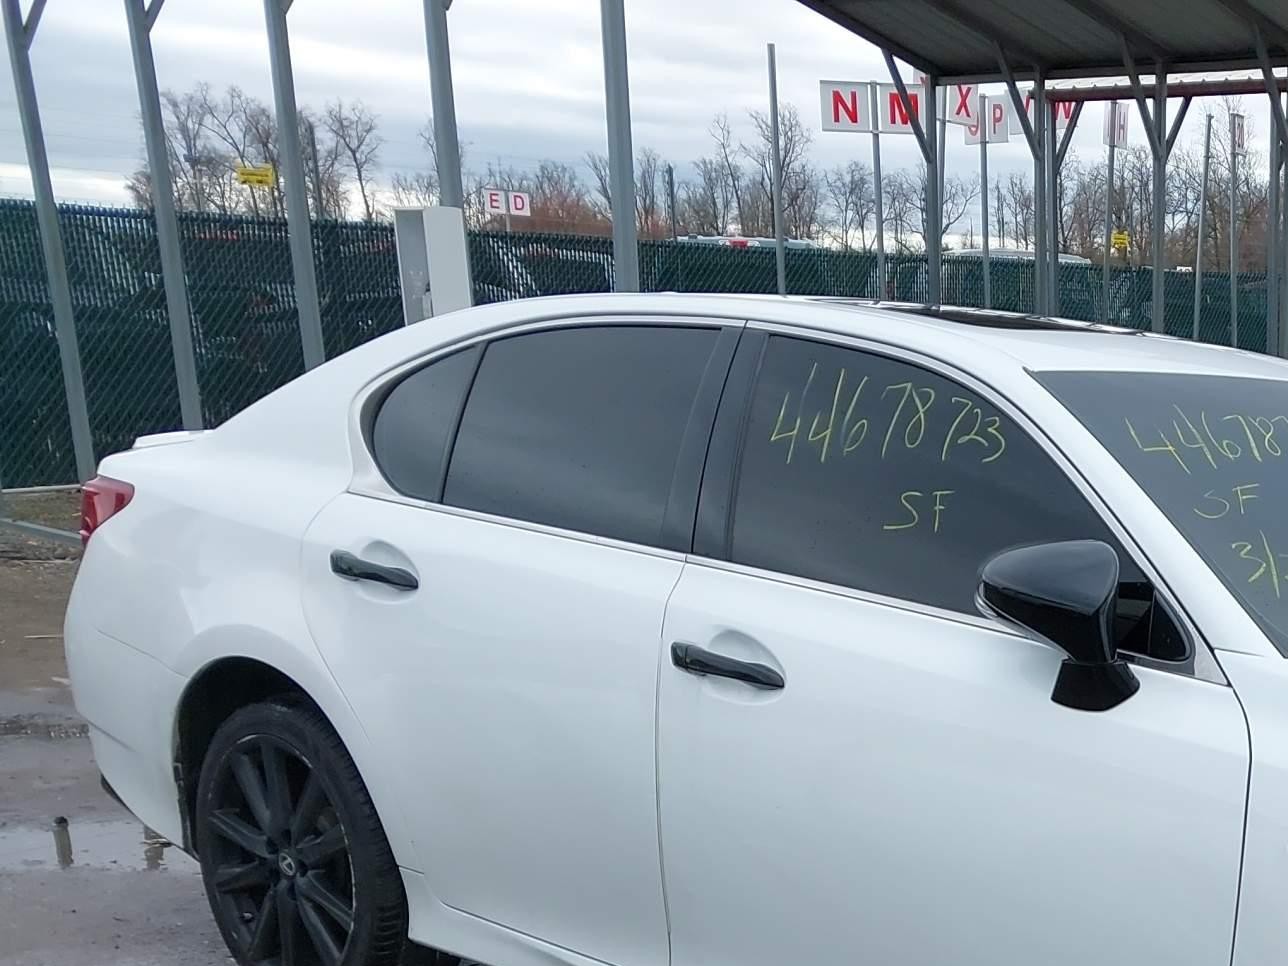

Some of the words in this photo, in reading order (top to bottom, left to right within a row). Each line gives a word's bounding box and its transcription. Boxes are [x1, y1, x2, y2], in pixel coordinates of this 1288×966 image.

[832, 90, 858, 124] N
[889, 92, 919, 125] M
[992, 103, 1003, 135] P
[489, 192, 500, 209] E
[513, 194, 525, 211] D
[770, 362, 1006, 465] 44678723
